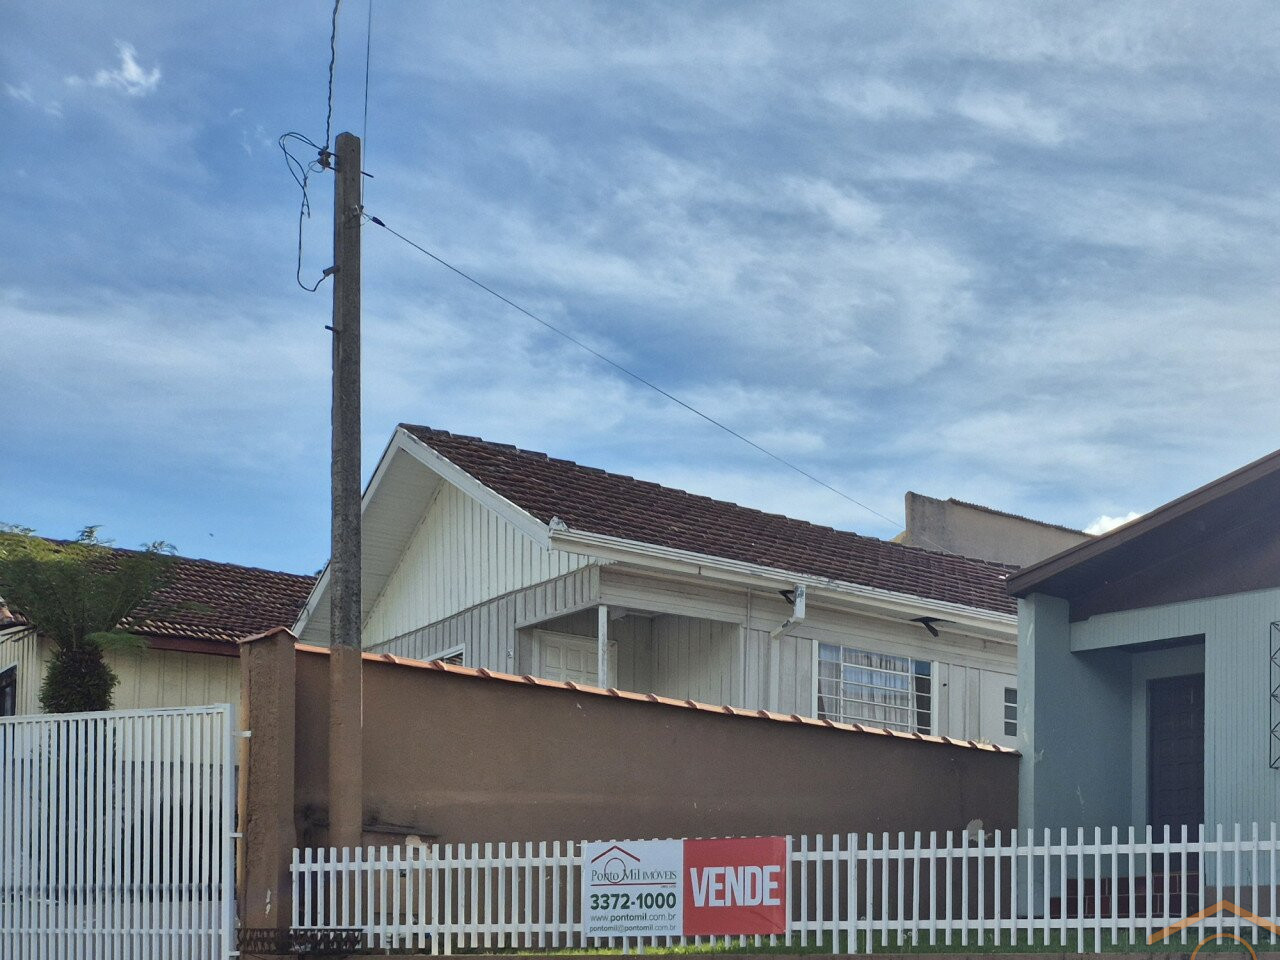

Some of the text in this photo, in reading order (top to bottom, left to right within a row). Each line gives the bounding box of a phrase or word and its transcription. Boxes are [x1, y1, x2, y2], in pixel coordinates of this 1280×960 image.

[591, 868, 677, 882] Ponto Mil IMÓVEIS
[690, 865, 781, 907] VENDE
[590, 892, 677, 910] 3372-1000
[590, 913, 676, 923] www.pontomil.com.br
[589, 924, 676, 933] pontomil@pontomil.com.br
